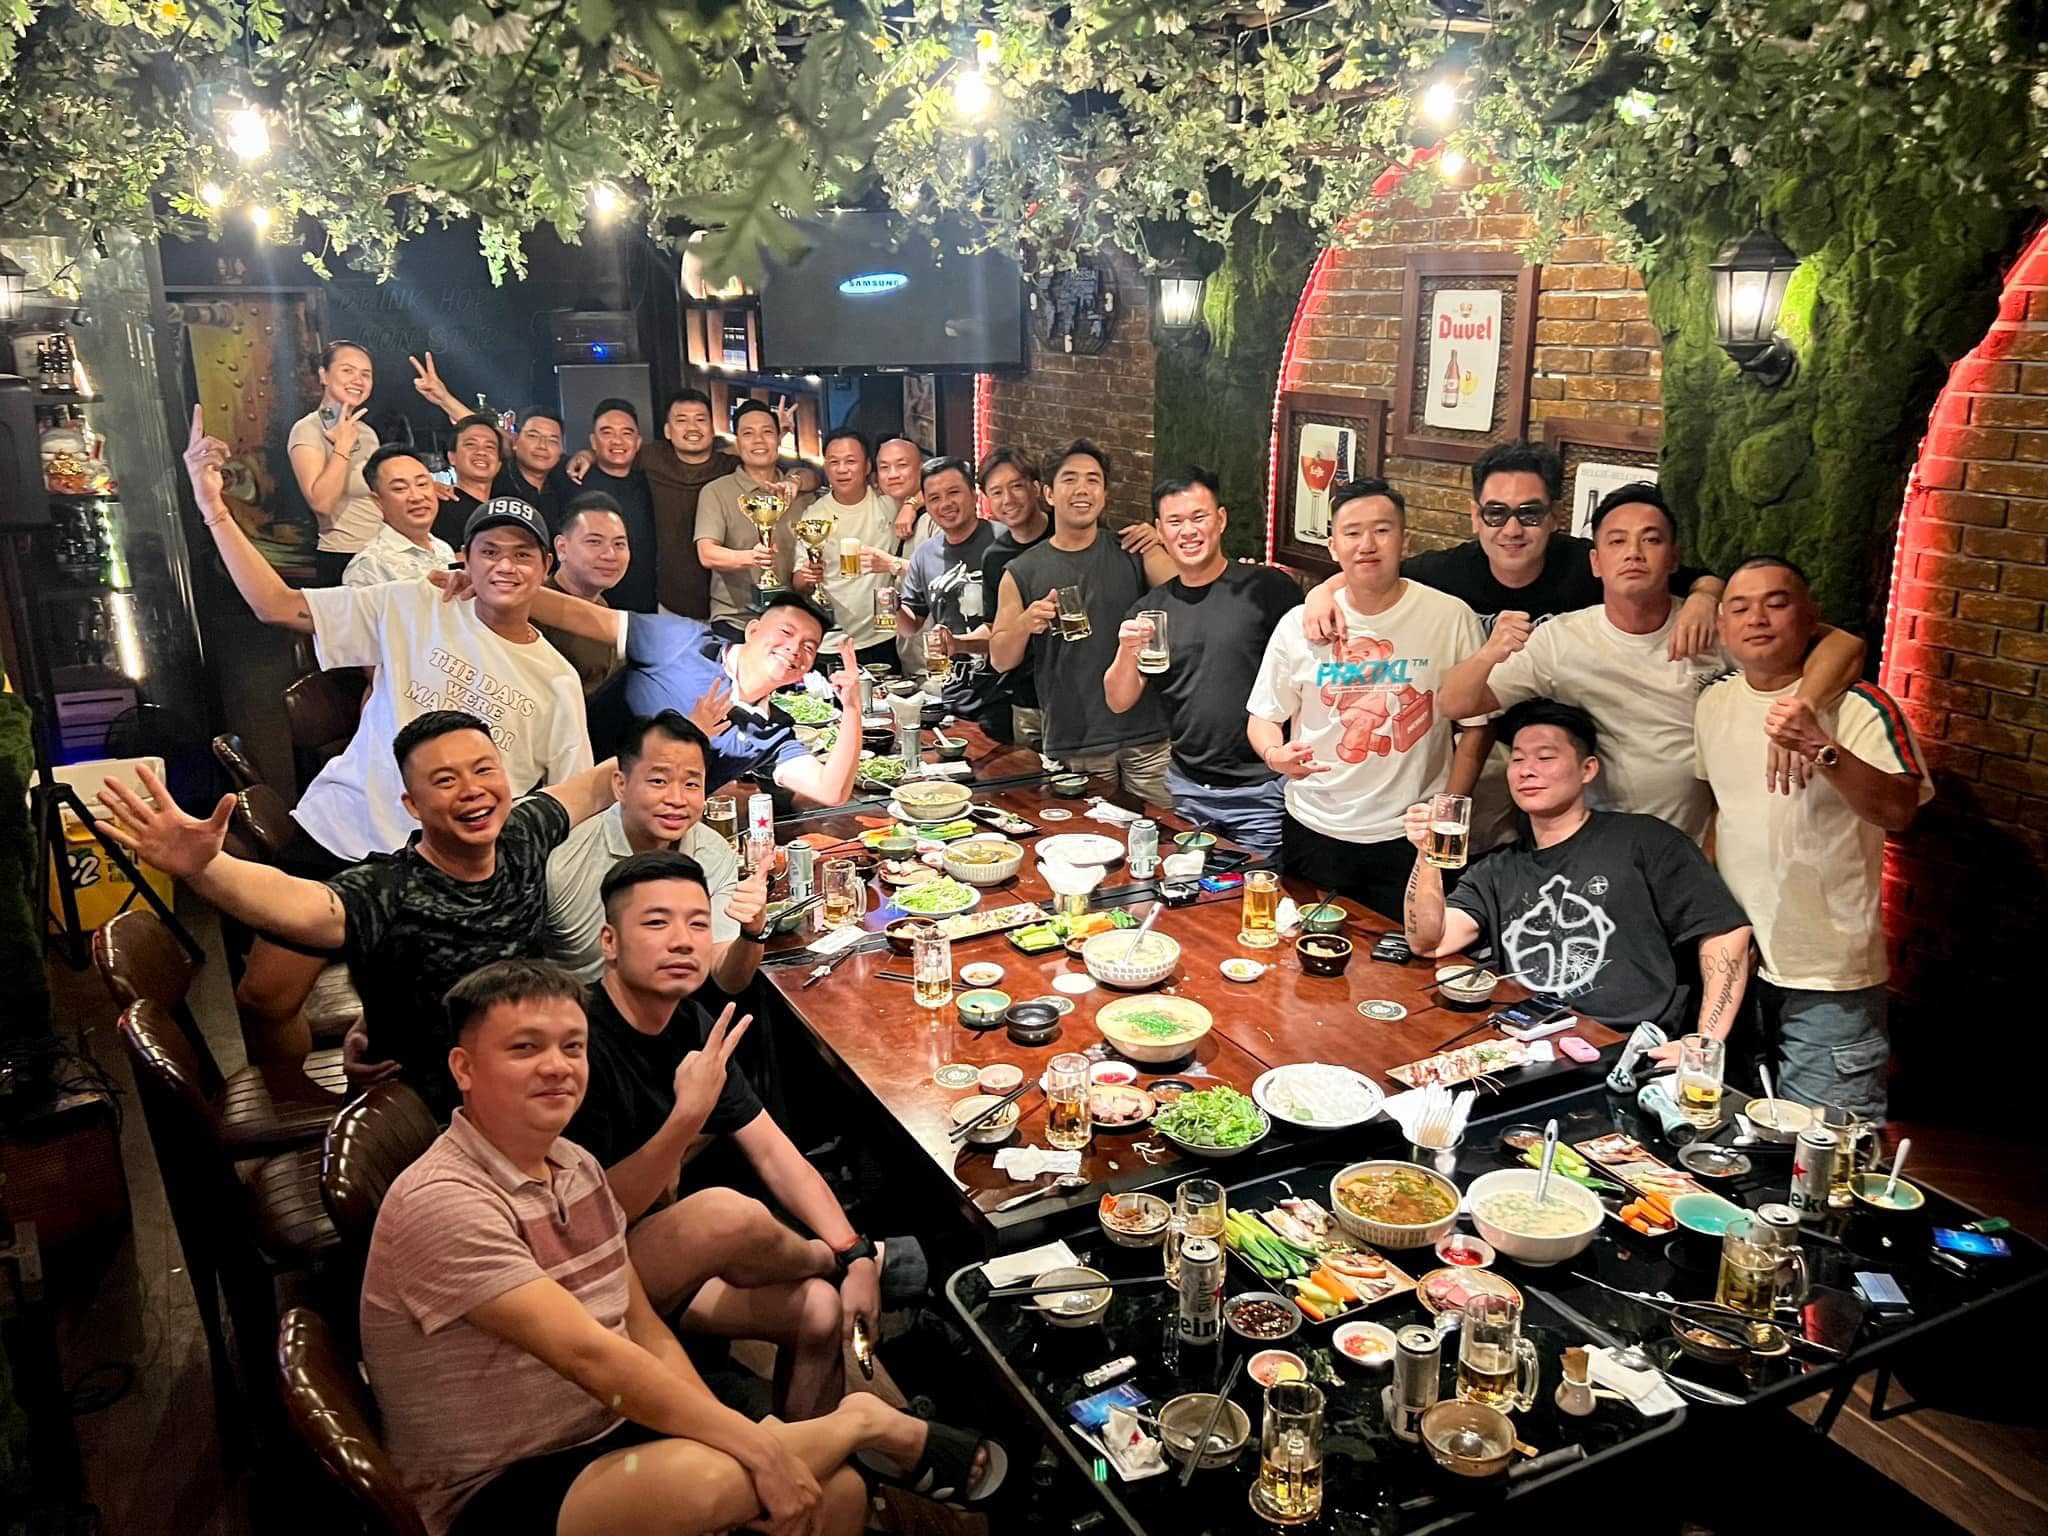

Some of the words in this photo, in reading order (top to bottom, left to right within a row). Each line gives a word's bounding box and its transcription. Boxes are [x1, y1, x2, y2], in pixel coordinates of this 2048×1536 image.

[1104, 292, 1114, 313] 3
[1438, 314, 1493, 341] Duvel
[487, 500, 534, 522] 1969
[429, 648, 478, 686] THE
[478, 674, 536, 718] DAYS
[447, 680, 506, 722] WERE
